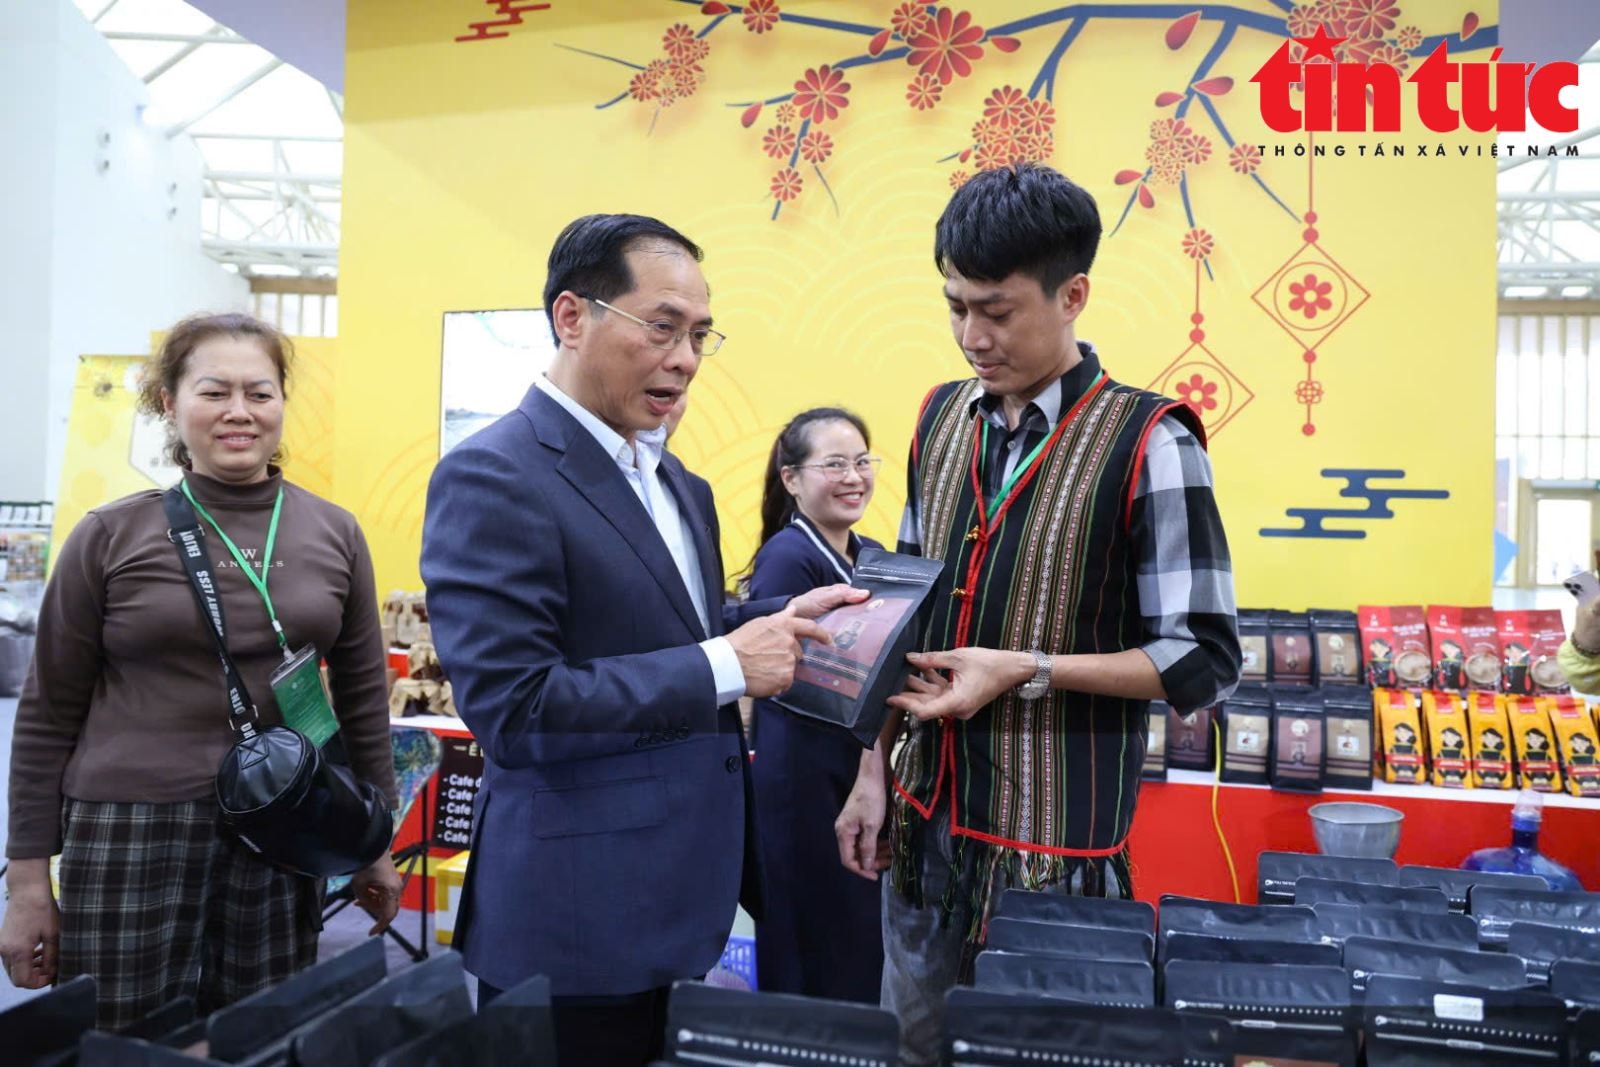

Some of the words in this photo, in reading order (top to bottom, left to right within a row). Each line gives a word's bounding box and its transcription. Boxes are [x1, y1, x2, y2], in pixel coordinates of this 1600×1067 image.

[240, 548, 257, 560] W
[449, 774, 474, 787] Cafe
[448, 788, 473, 802] Cafe
[446, 802, 471, 816] Cafe
[445, 816, 470, 830] Cafe
[443, 830, 469, 844] Cafe
